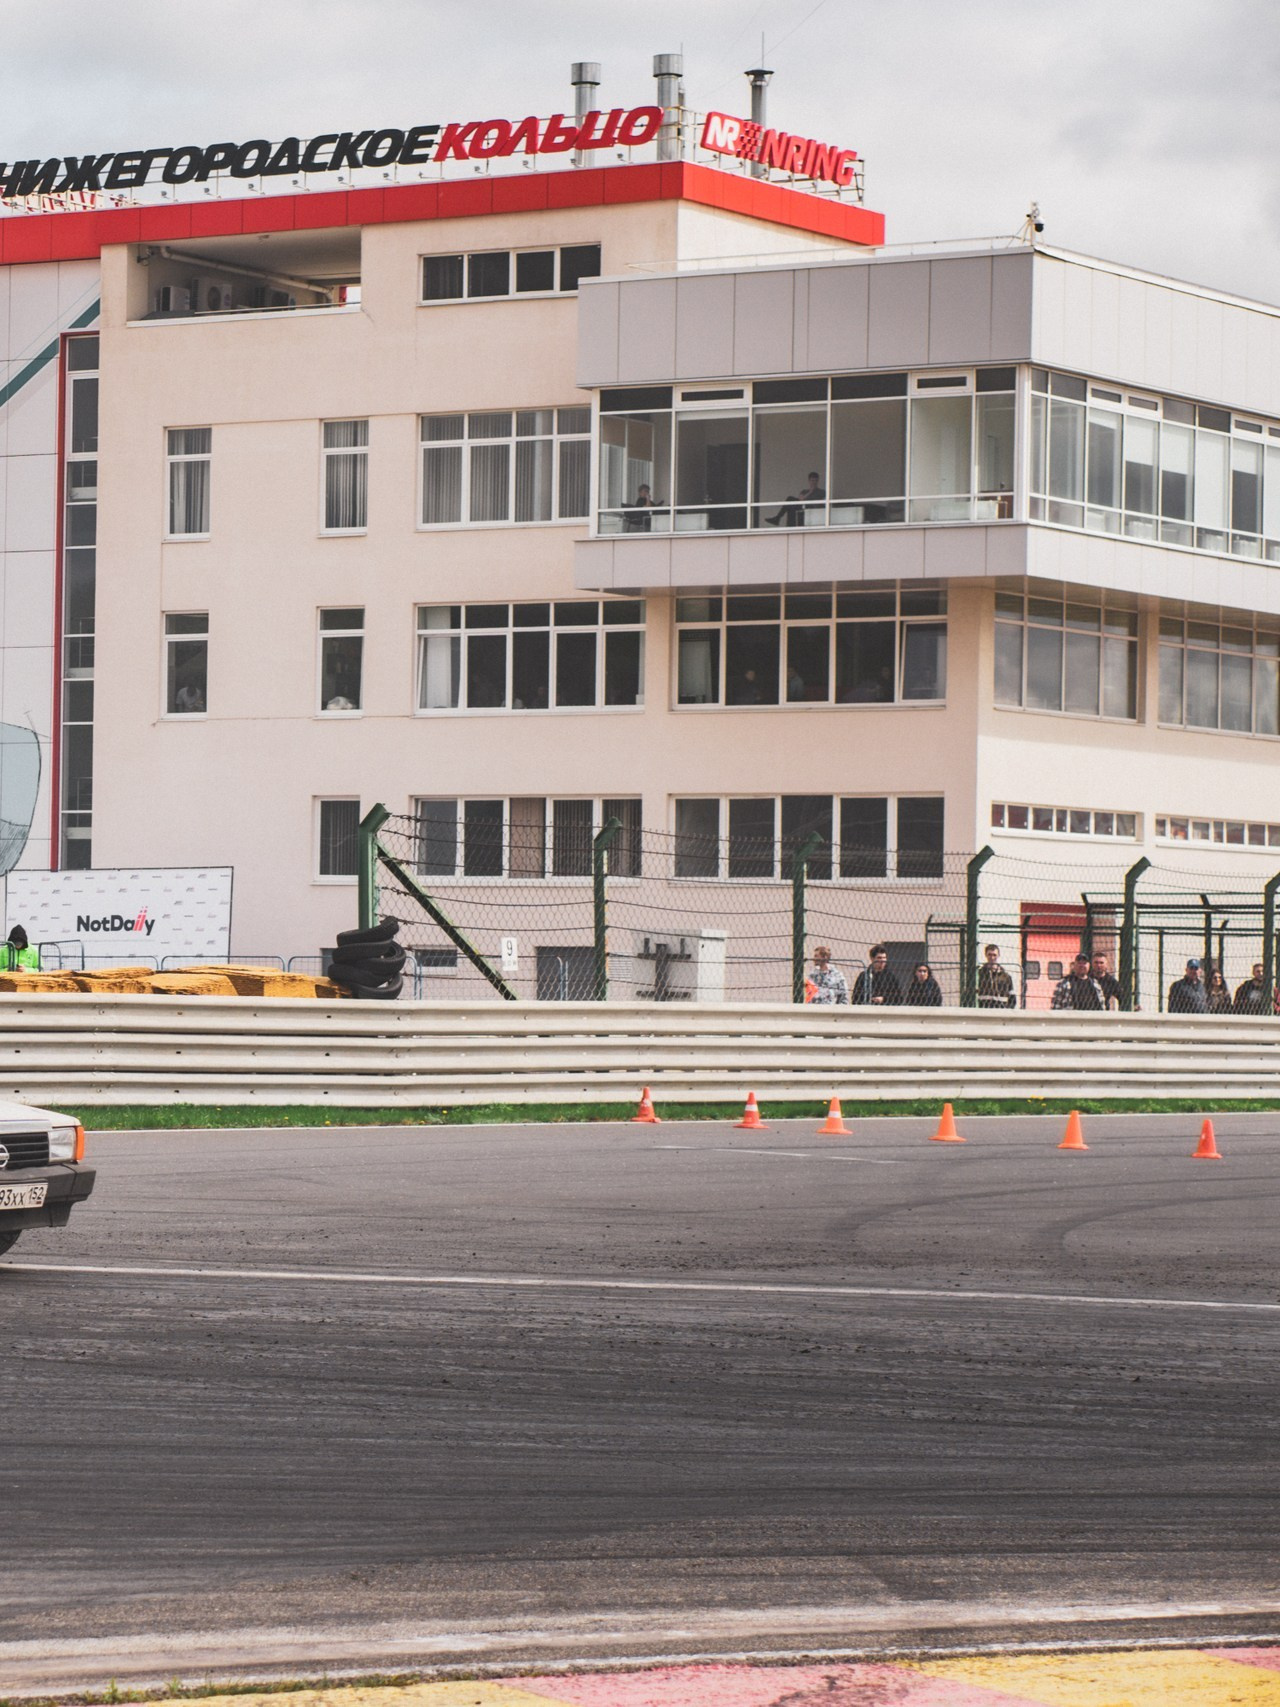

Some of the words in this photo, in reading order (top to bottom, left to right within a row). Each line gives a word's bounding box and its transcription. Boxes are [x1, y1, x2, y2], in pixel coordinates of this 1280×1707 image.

[433, 106, 664, 162] КОЛЬЦО
[758, 129, 857, 186] NRING
[507, 940, 513, 956] 9
[28, 1186, 44, 1201] 152
